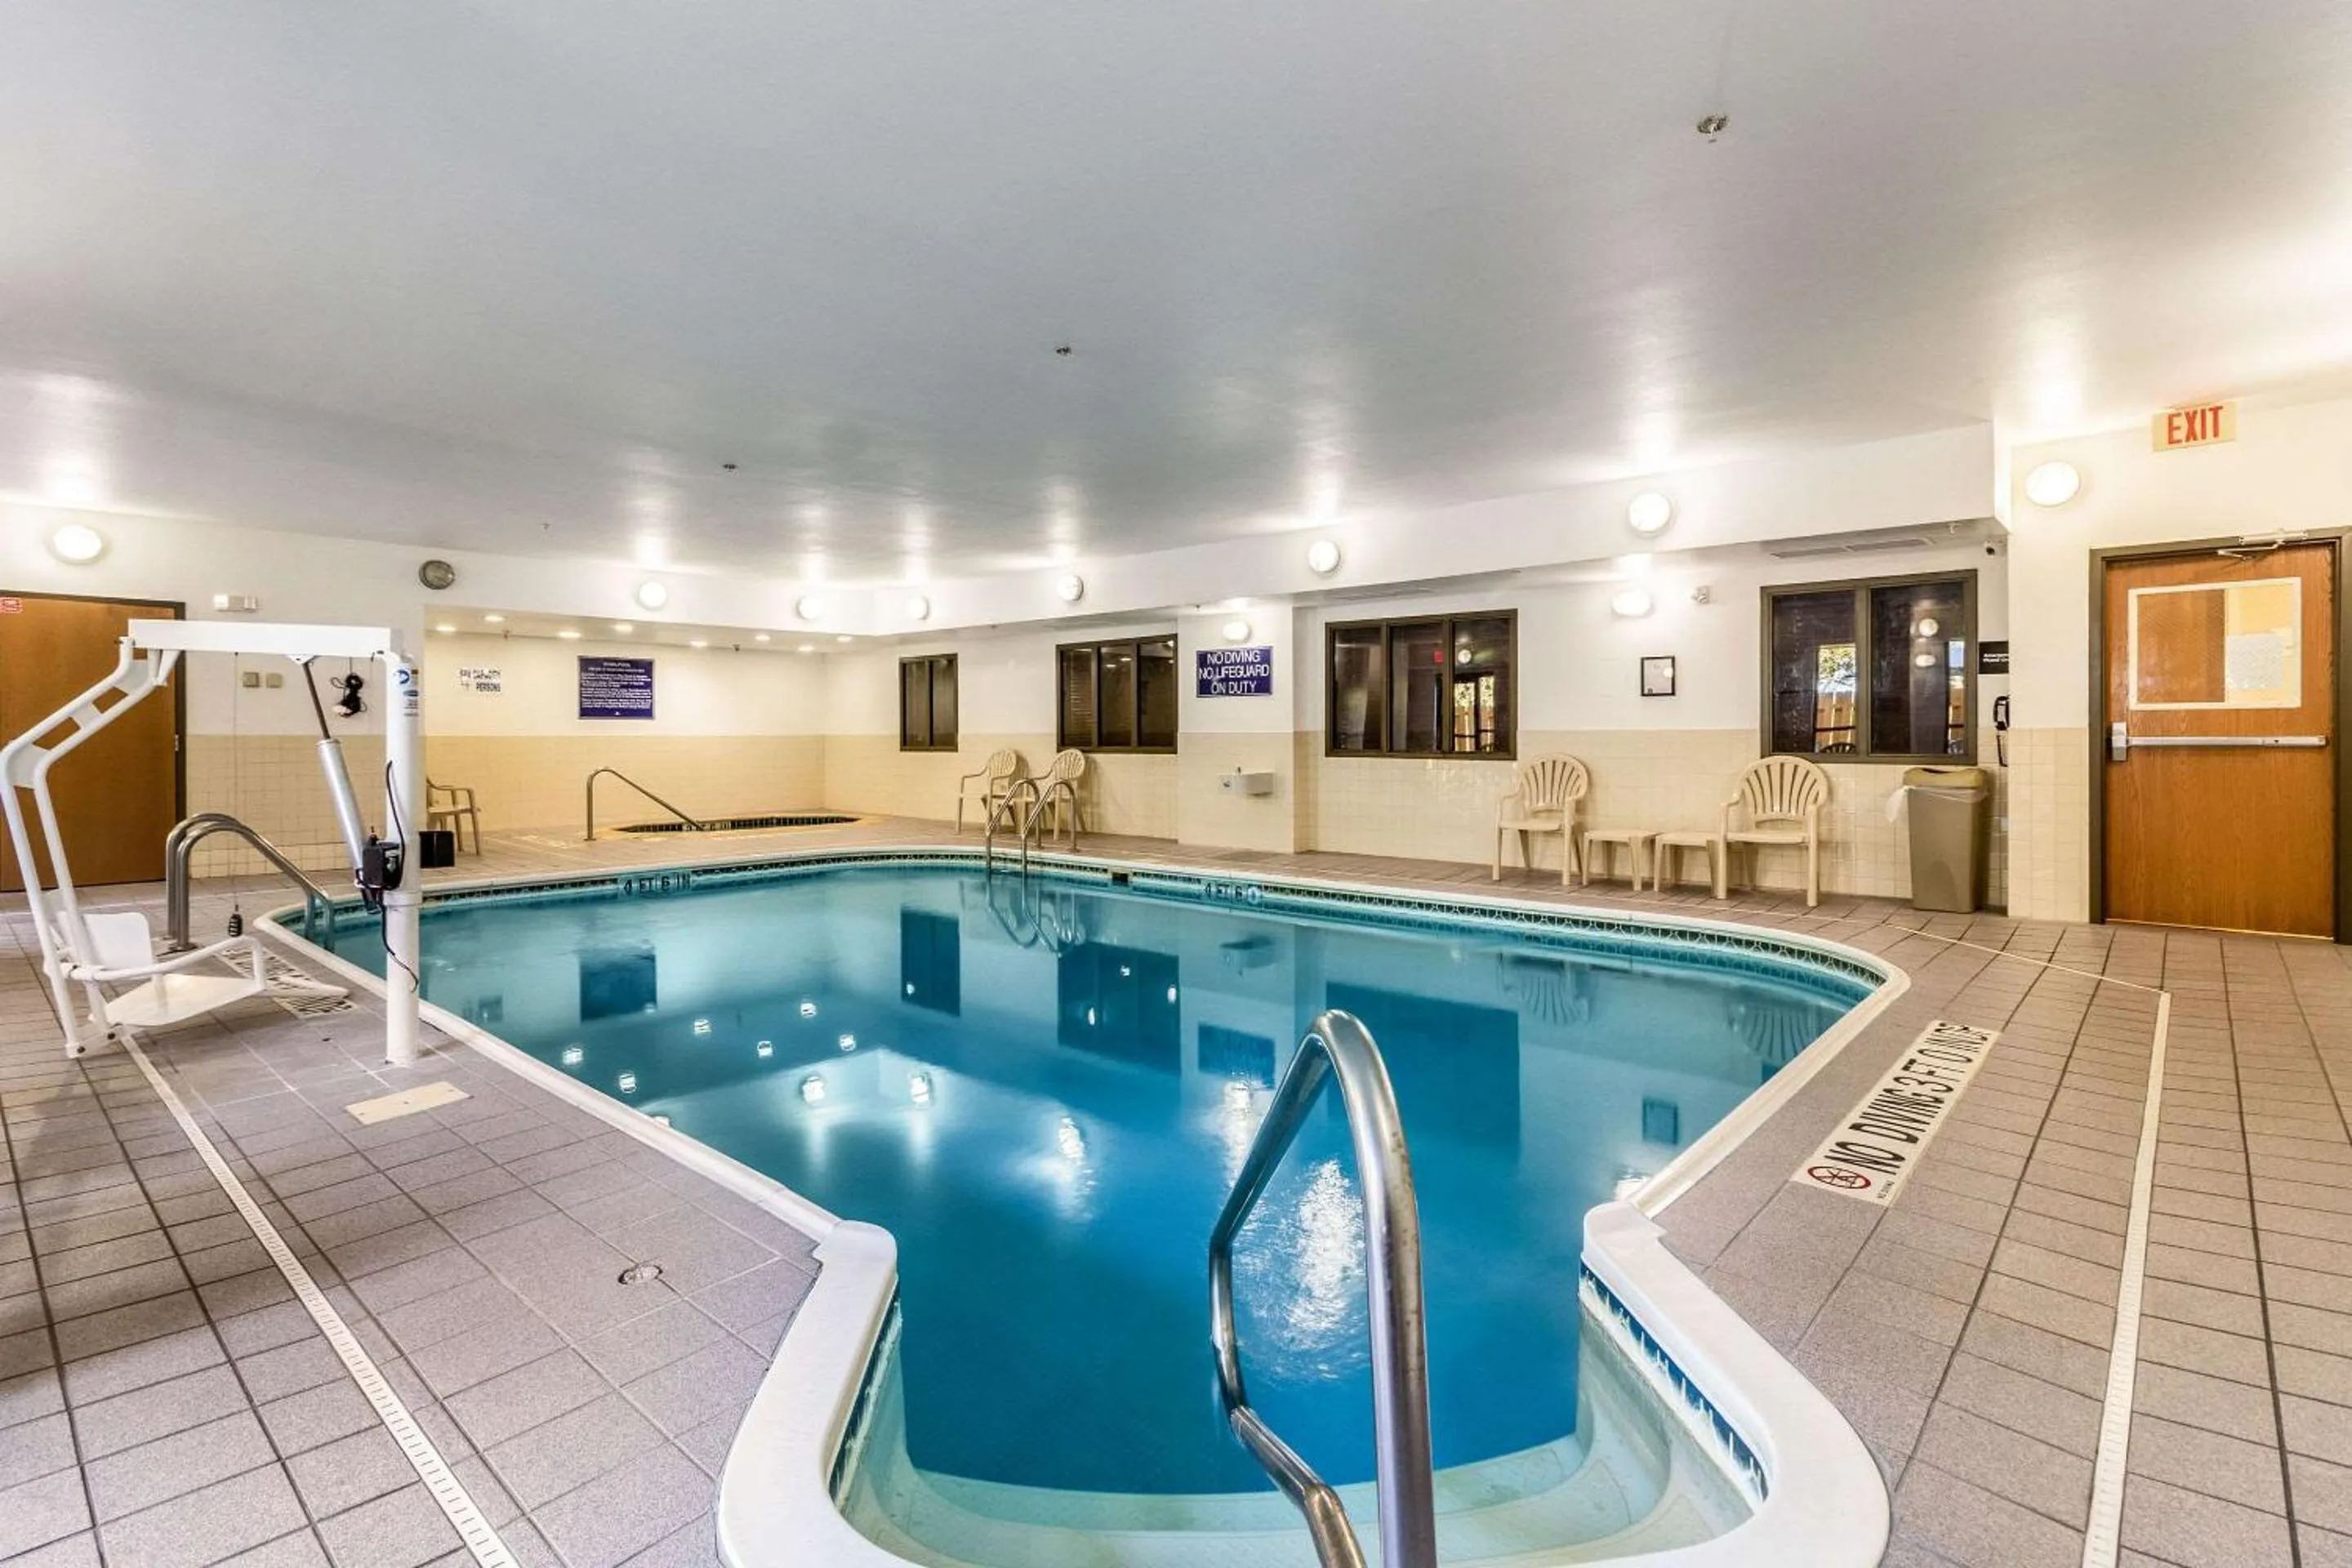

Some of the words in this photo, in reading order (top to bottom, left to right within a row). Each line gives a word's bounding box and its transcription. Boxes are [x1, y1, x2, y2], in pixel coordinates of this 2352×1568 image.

[2167, 406, 2224, 445] EXIT
[1206, 652, 1223, 665] NO
[1224, 650, 1260, 664] DIVING
[1199, 667, 1214, 680] NO
[1216, 664, 1269, 679] LIFEGUARD
[1211, 681, 1227, 694] ON
[1228, 680, 1257, 694] DUTY
[1900, 1058, 1967, 1083] FT
[1892, 1076, 1954, 1093] 3
[1847, 1088, 1945, 1144] DIVING
[1824, 1141, 1906, 1176] NO
